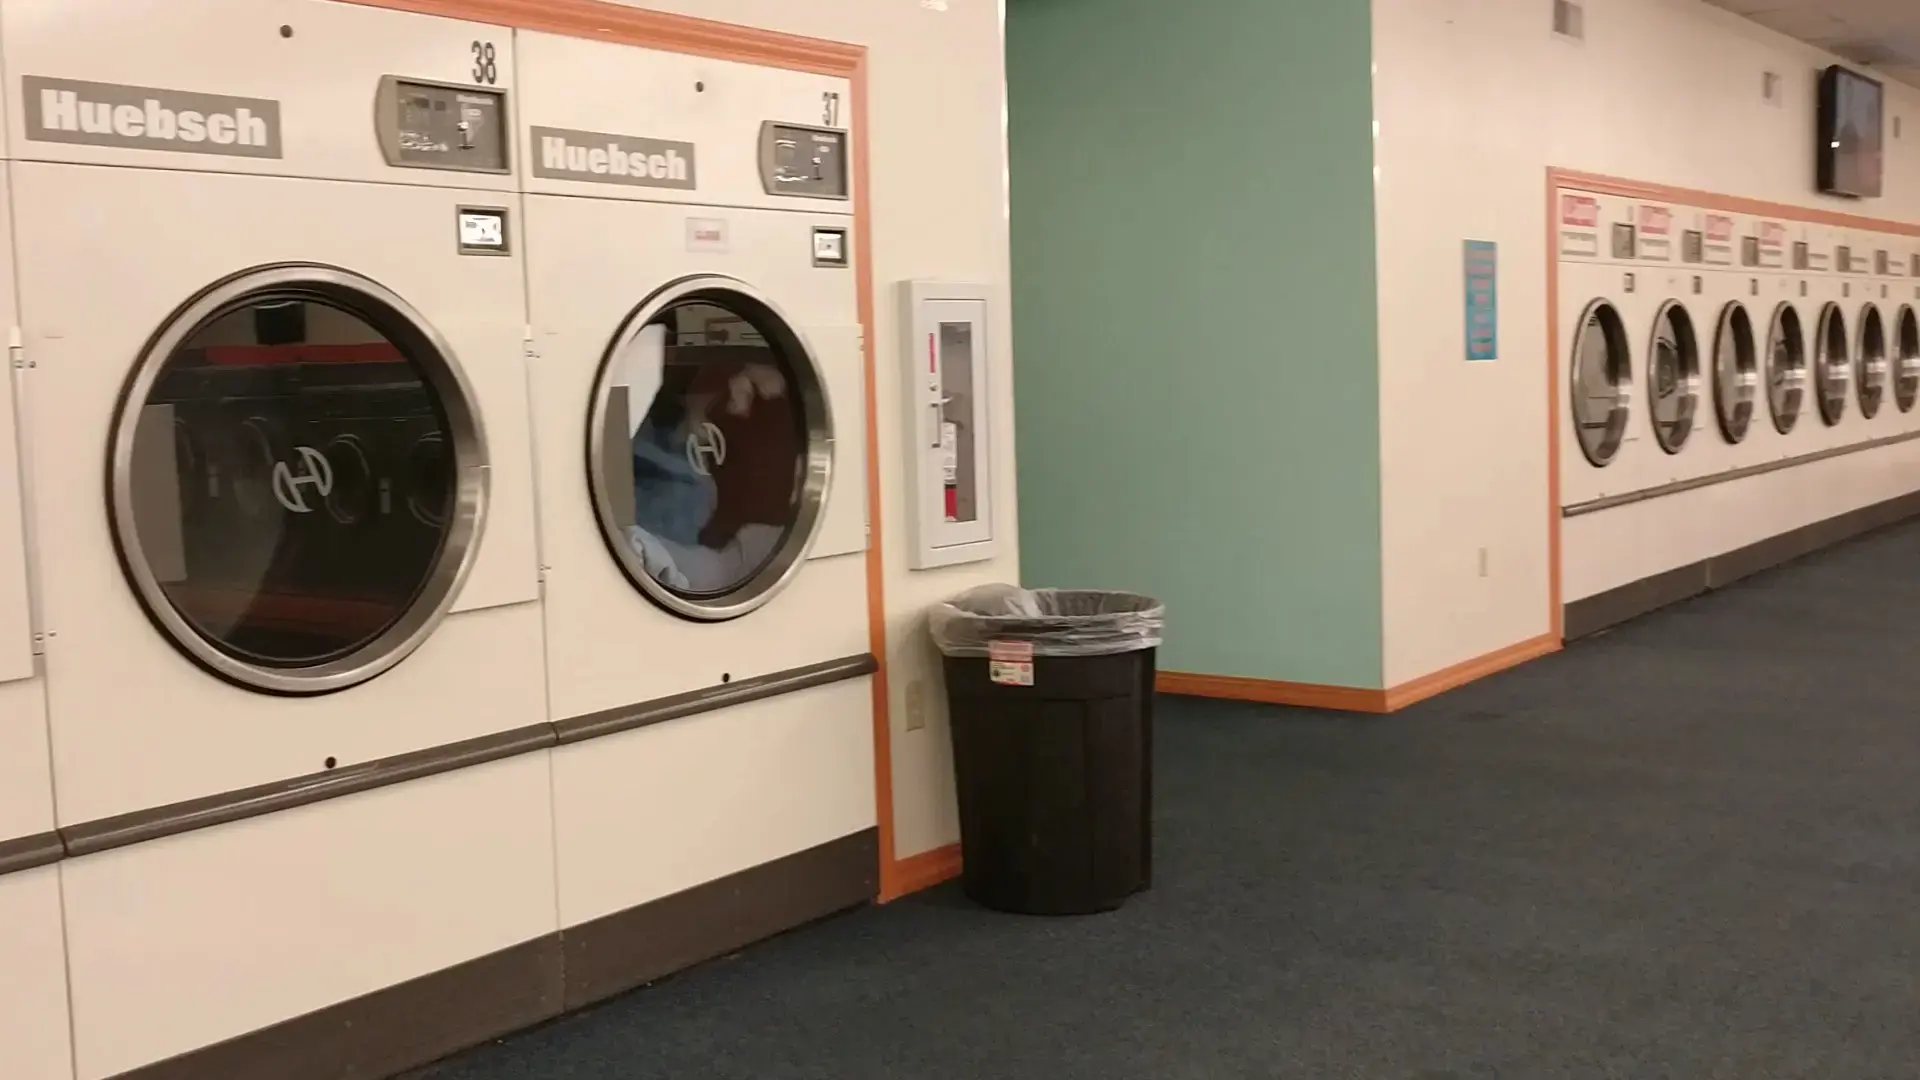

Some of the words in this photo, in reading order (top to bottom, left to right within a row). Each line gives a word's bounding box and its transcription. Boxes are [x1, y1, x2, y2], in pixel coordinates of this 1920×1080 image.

[471, 40, 496, 84] 38
[40, 88, 268, 147] Huebsch
[822, 91, 840, 126] 37
[540, 136, 688, 181] Huebsch
